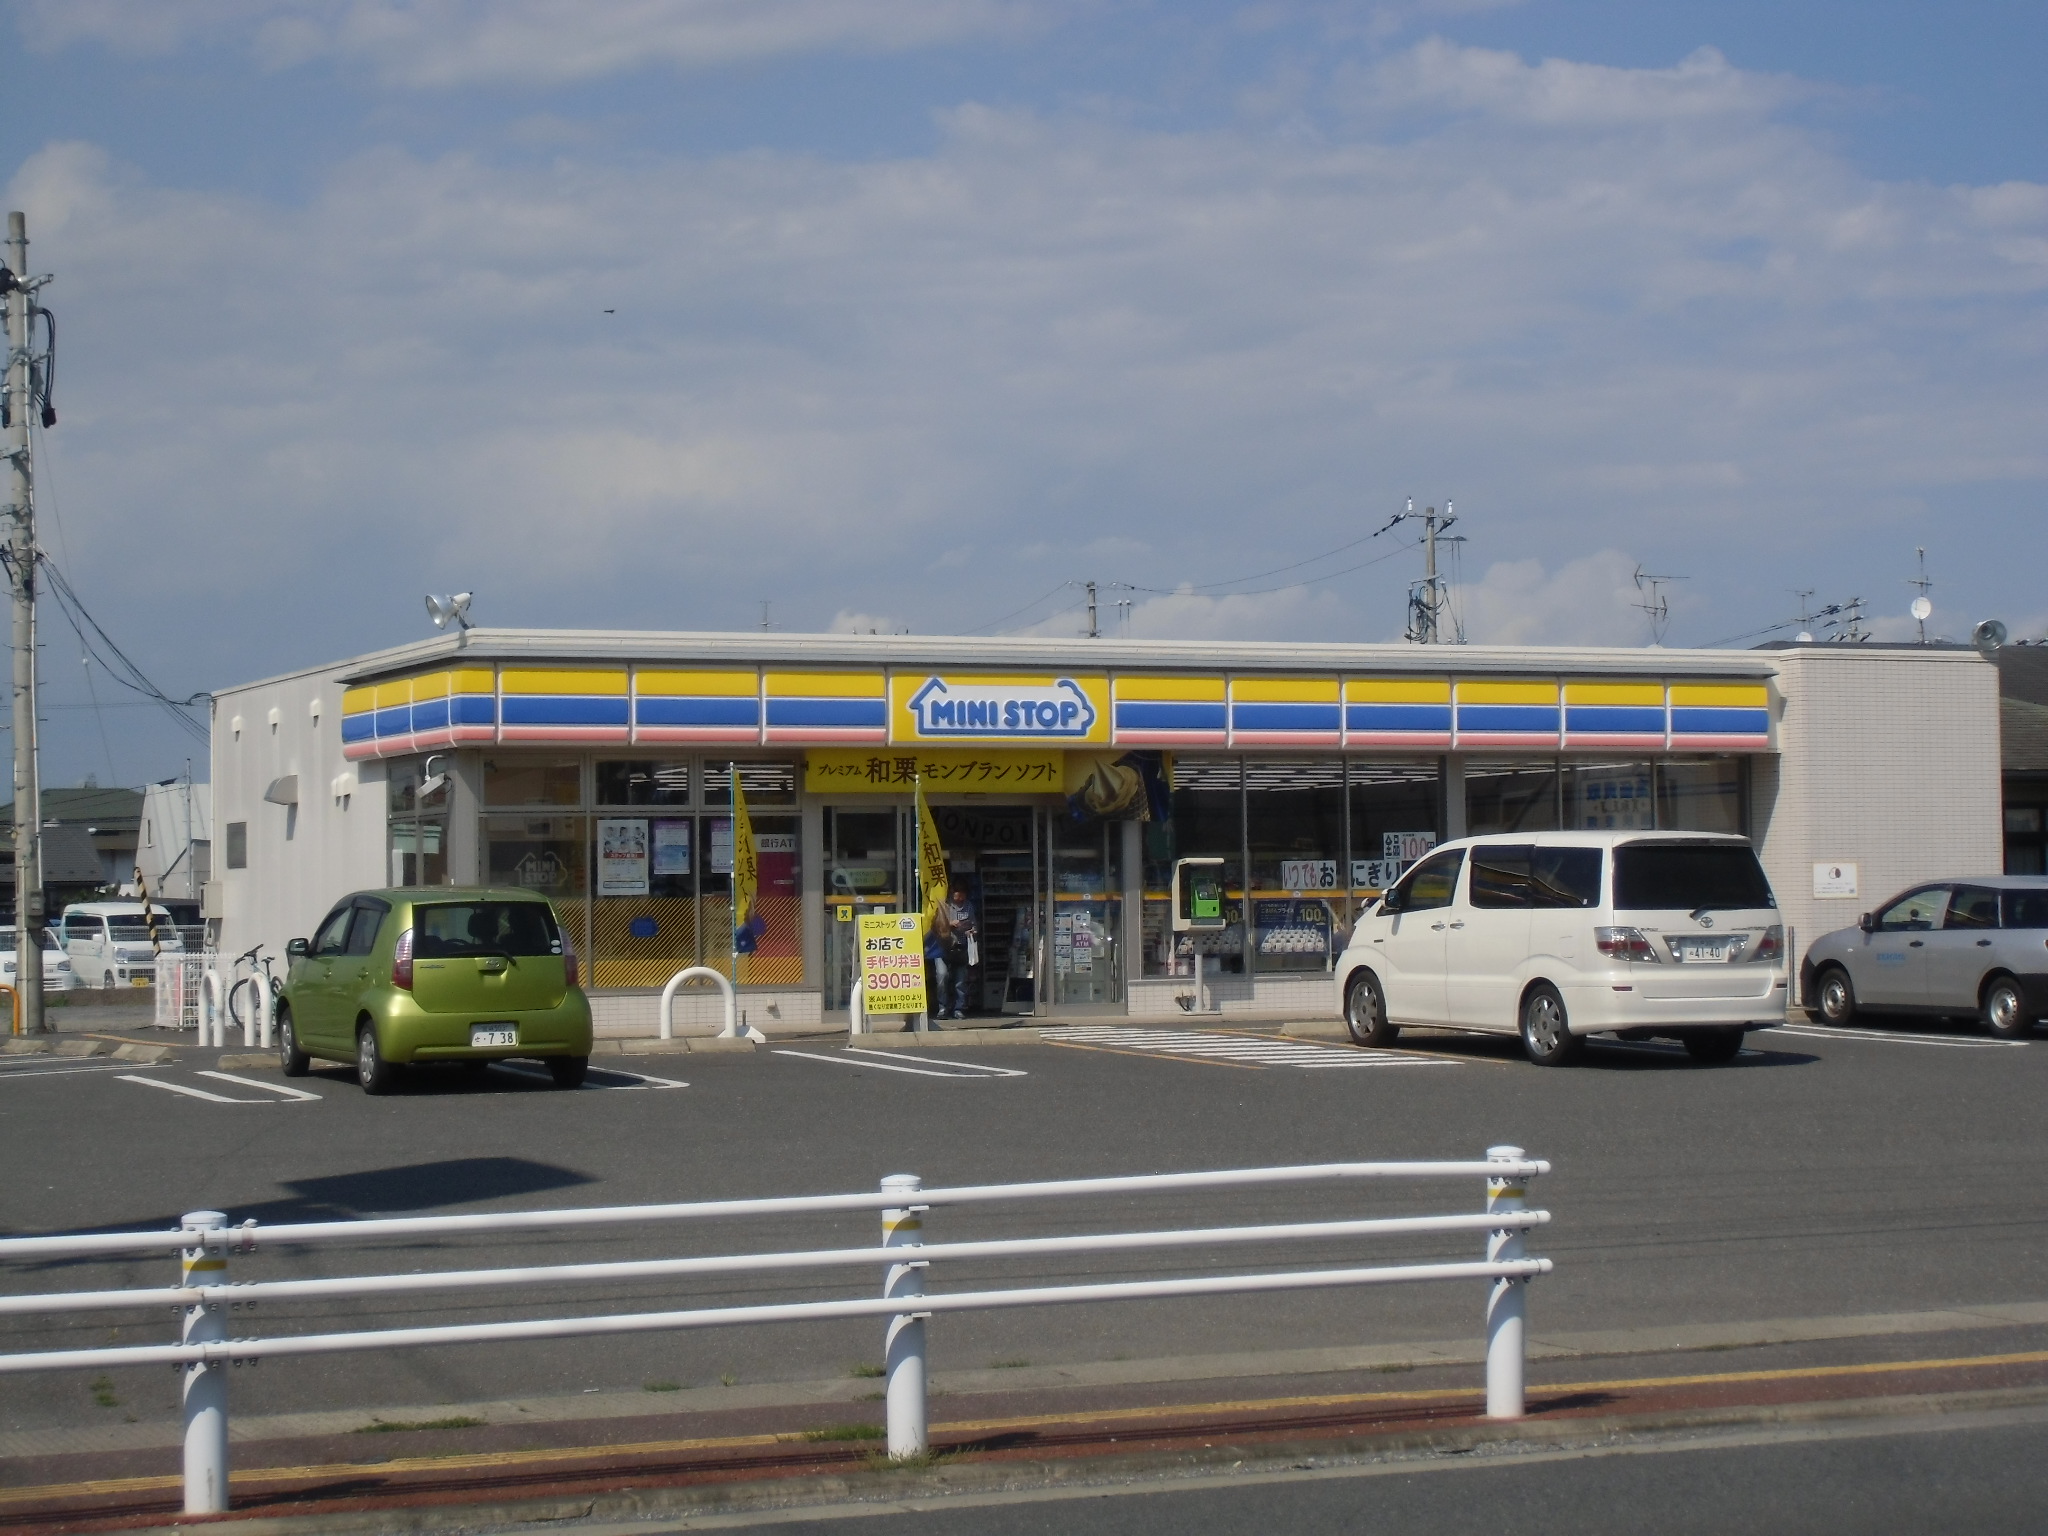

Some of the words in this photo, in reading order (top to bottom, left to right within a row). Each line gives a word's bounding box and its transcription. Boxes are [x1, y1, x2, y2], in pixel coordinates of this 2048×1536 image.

[930, 700, 998, 727] MINI
[1003, 700, 1079, 727] STOP
[761, 838, 797, 849] 銀行AT
[525, 860, 556, 872] MINI
[525, 872, 557, 883] STOP
[863, 920, 897, 929] ミニストップ
[865, 937, 904, 951] お店で
[866, 955, 921, 969] 手作り弁当
